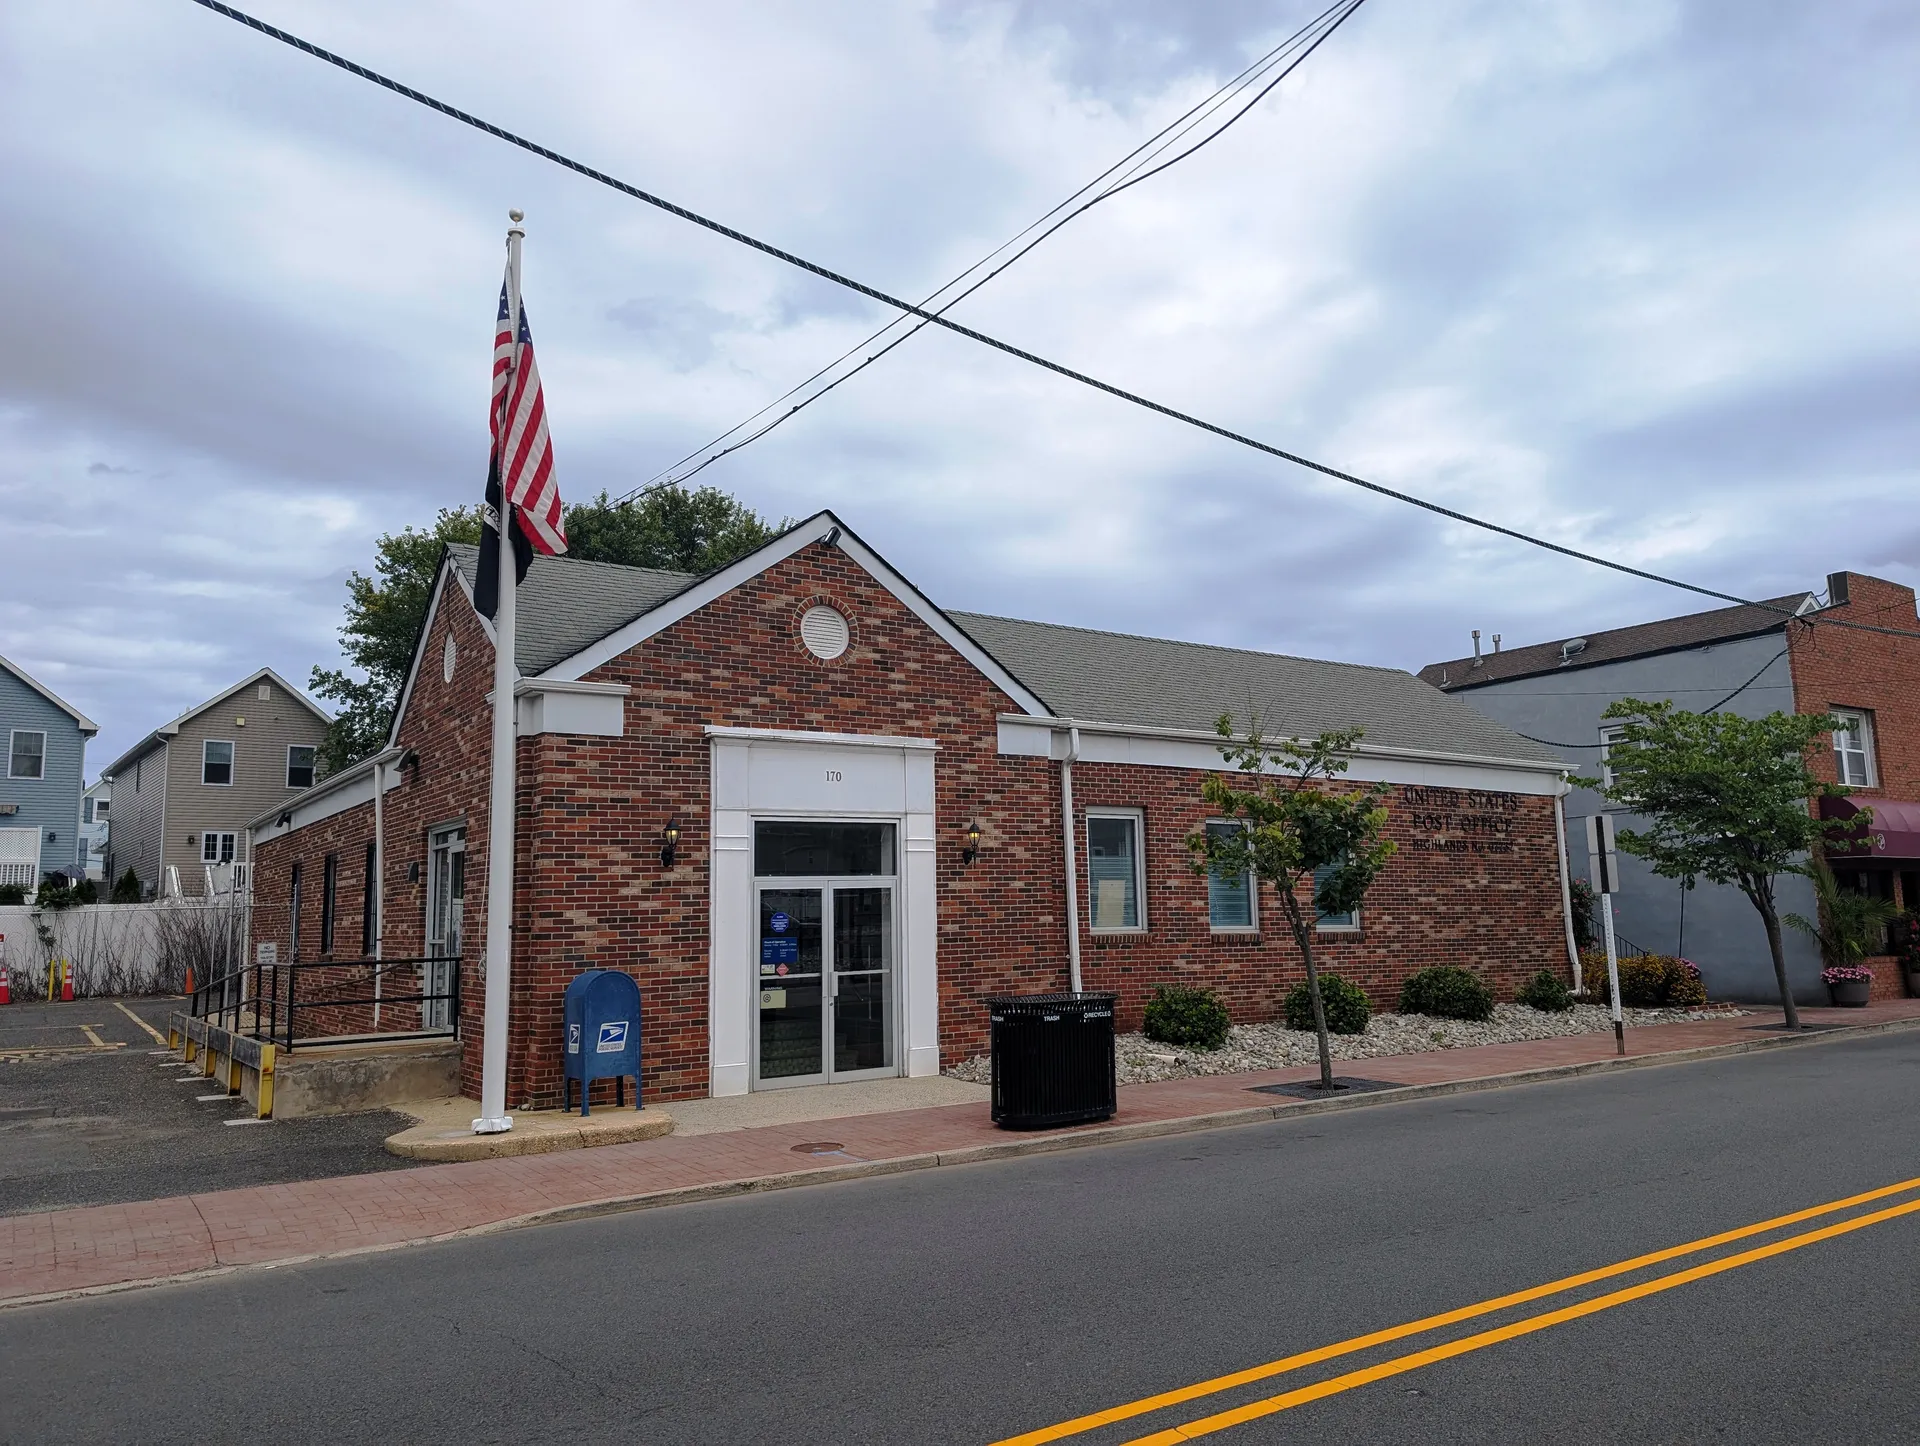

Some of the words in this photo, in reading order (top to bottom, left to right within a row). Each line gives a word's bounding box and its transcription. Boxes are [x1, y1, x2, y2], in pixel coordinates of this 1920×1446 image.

[826, 771, 842, 782] 170
[1404, 786, 1459, 807] UNITED
[1468, 790, 1517, 811] STATES
[1412, 812, 1452, 832] POST
[1461, 815, 1512, 833] OFFICE
[1088, 1010, 1107, 1018] RECYCLE
